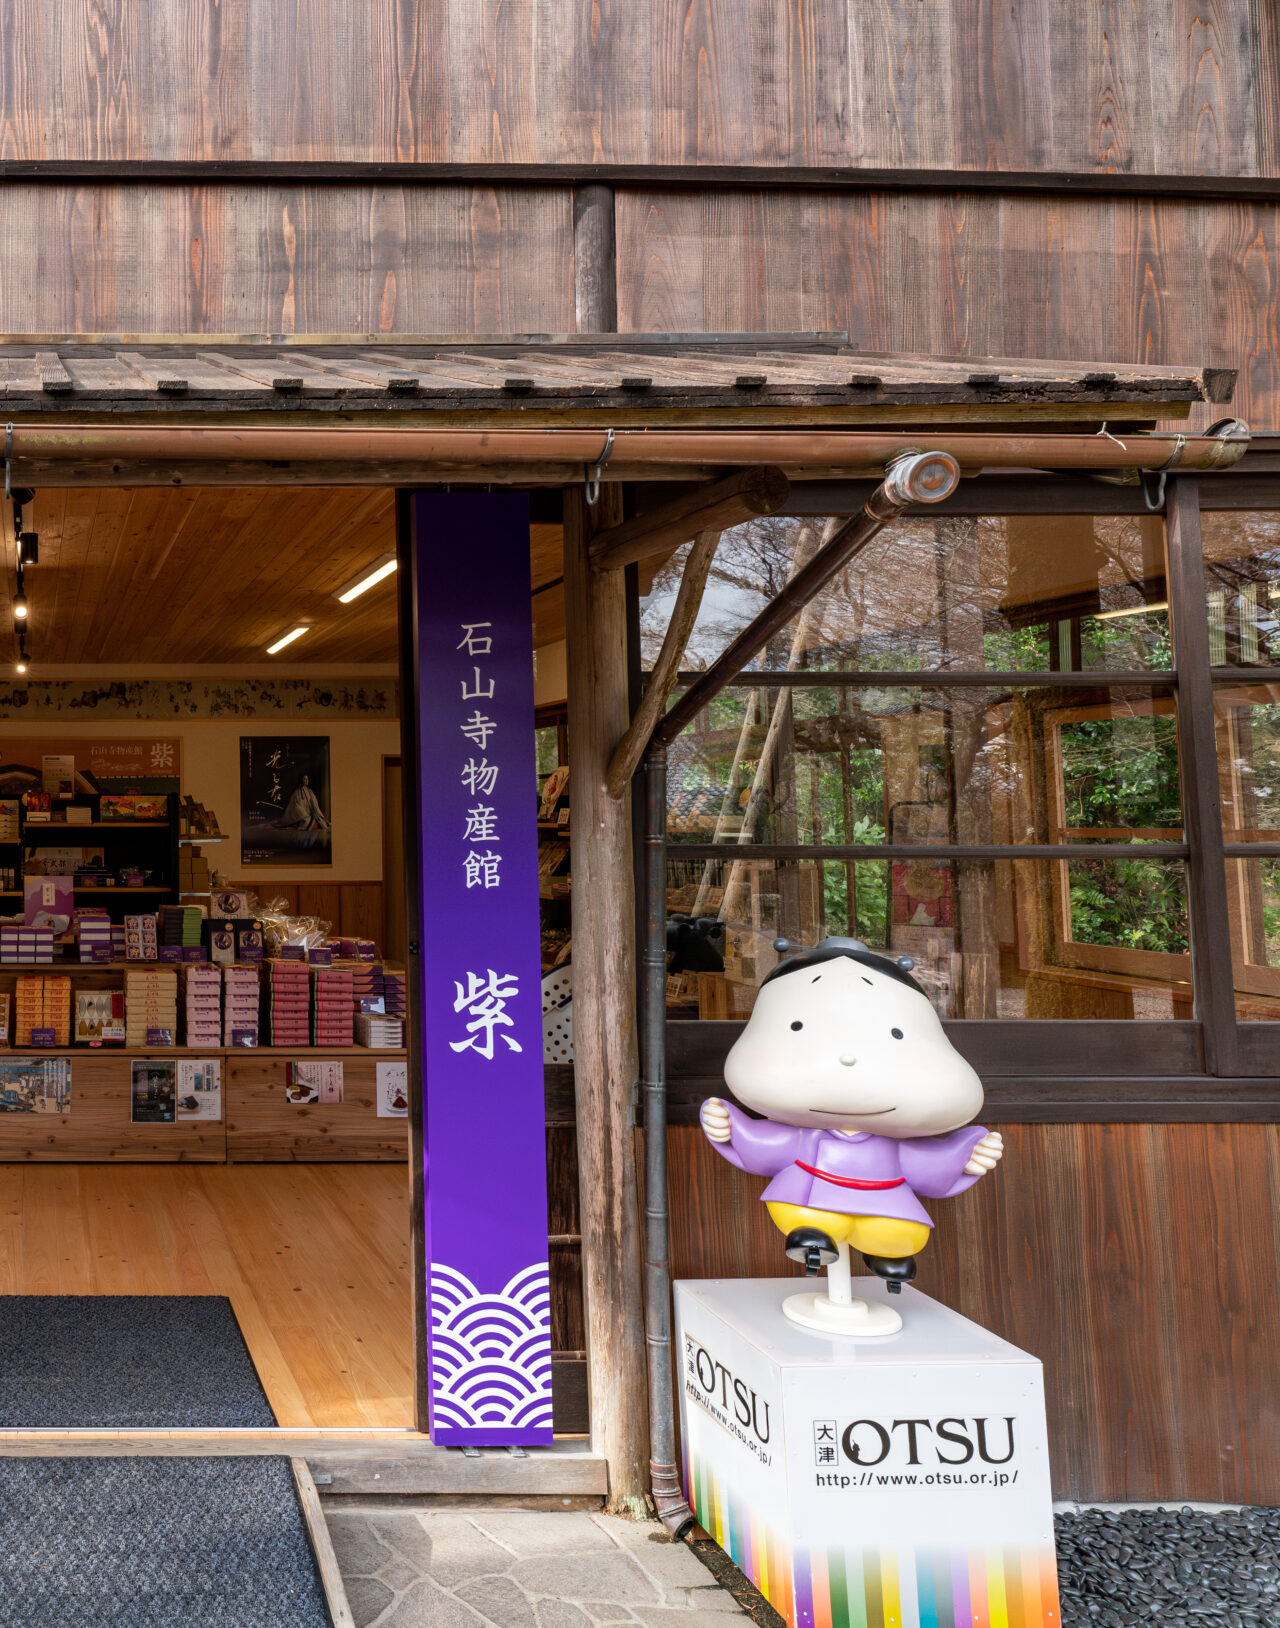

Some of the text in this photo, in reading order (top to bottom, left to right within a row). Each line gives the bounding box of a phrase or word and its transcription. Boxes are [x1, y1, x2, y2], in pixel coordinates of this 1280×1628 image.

[150, 743, 175, 768] 紫
[456, 622, 503, 889] 石山寺物産館
[449, 968, 523, 1061] 紫
[686, 1379, 772, 1467] http://www.otsu.or.jp/
[696, 1348, 770, 1444] OTSU
[816, 1424, 836, 1463] 大津
[841, 1417, 1017, 1467] OTSU
[816, 1469, 1019, 1489] http://www.otsu.or.jp/
